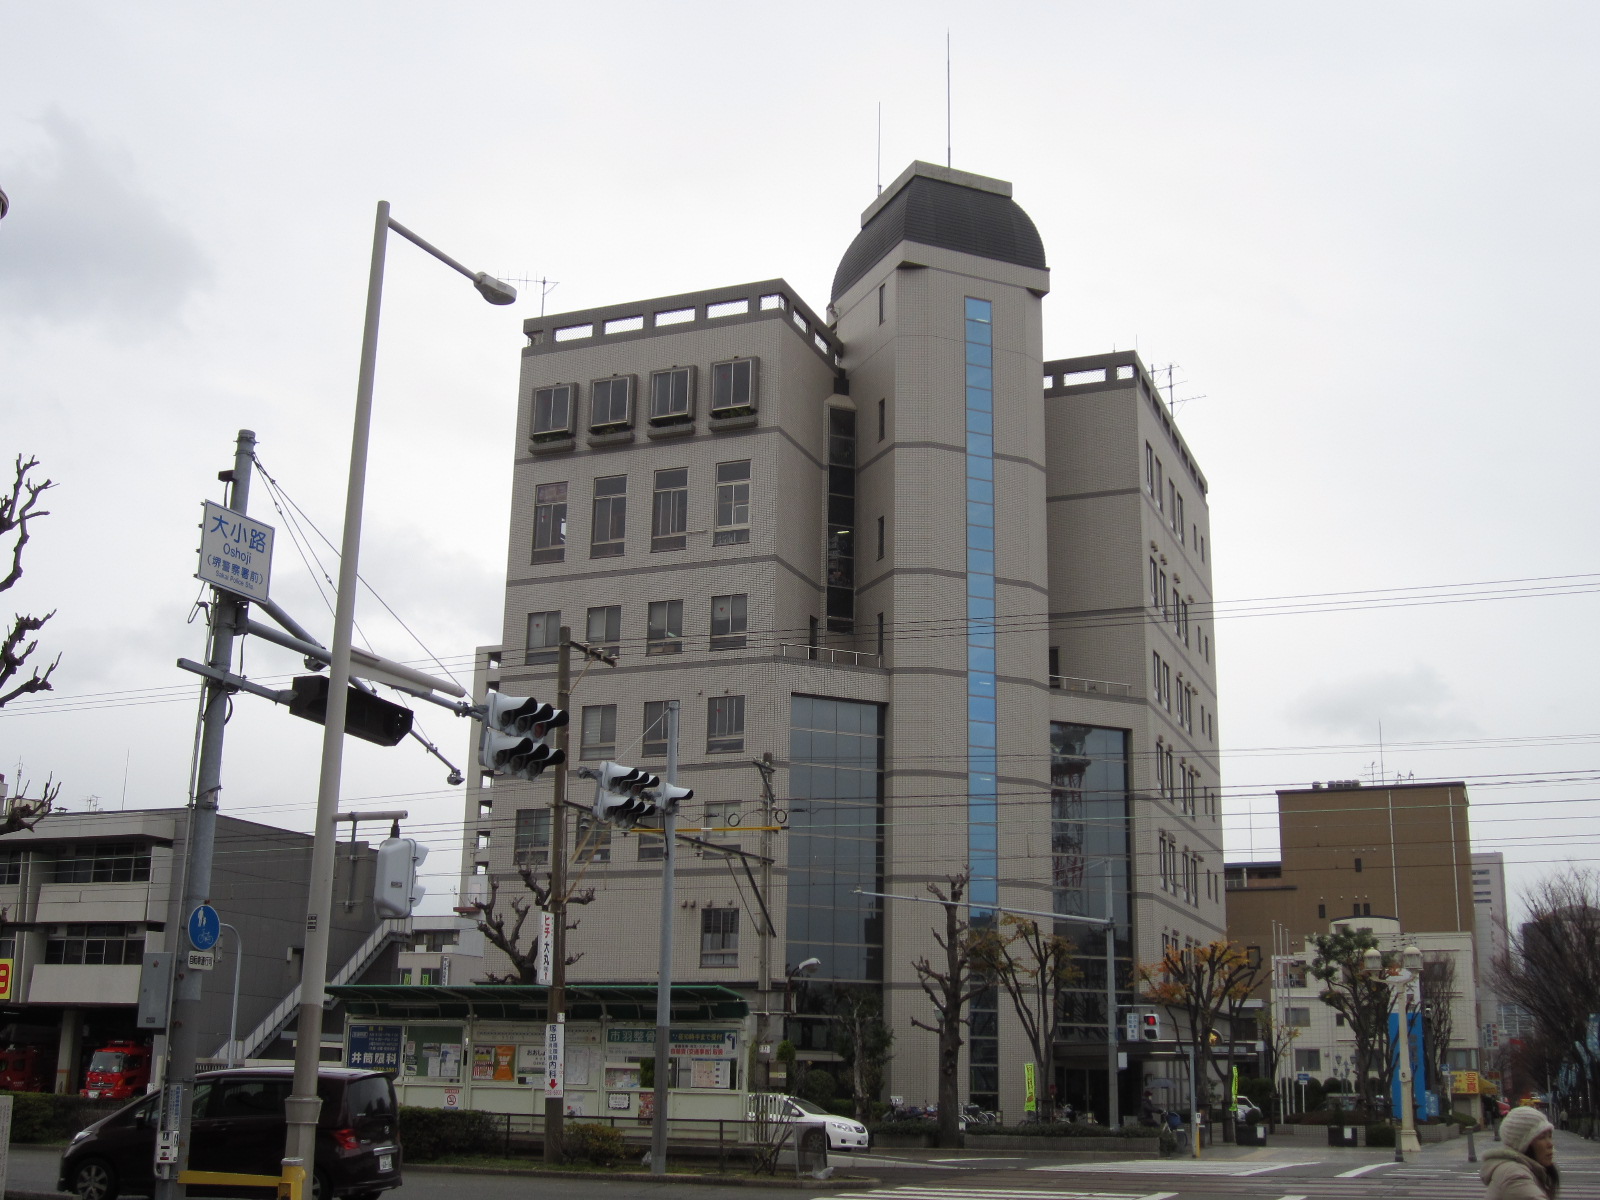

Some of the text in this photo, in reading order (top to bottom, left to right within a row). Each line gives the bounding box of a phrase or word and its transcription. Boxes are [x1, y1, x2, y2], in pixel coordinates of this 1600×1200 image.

[211, 515, 266, 553] 大小路
[223, 543, 251, 565] Oshoji
[216, 570, 228, 580] Sakai
[230, 576, 244, 586] Police
[352, 1052, 396, 1064] 井筒眼科
